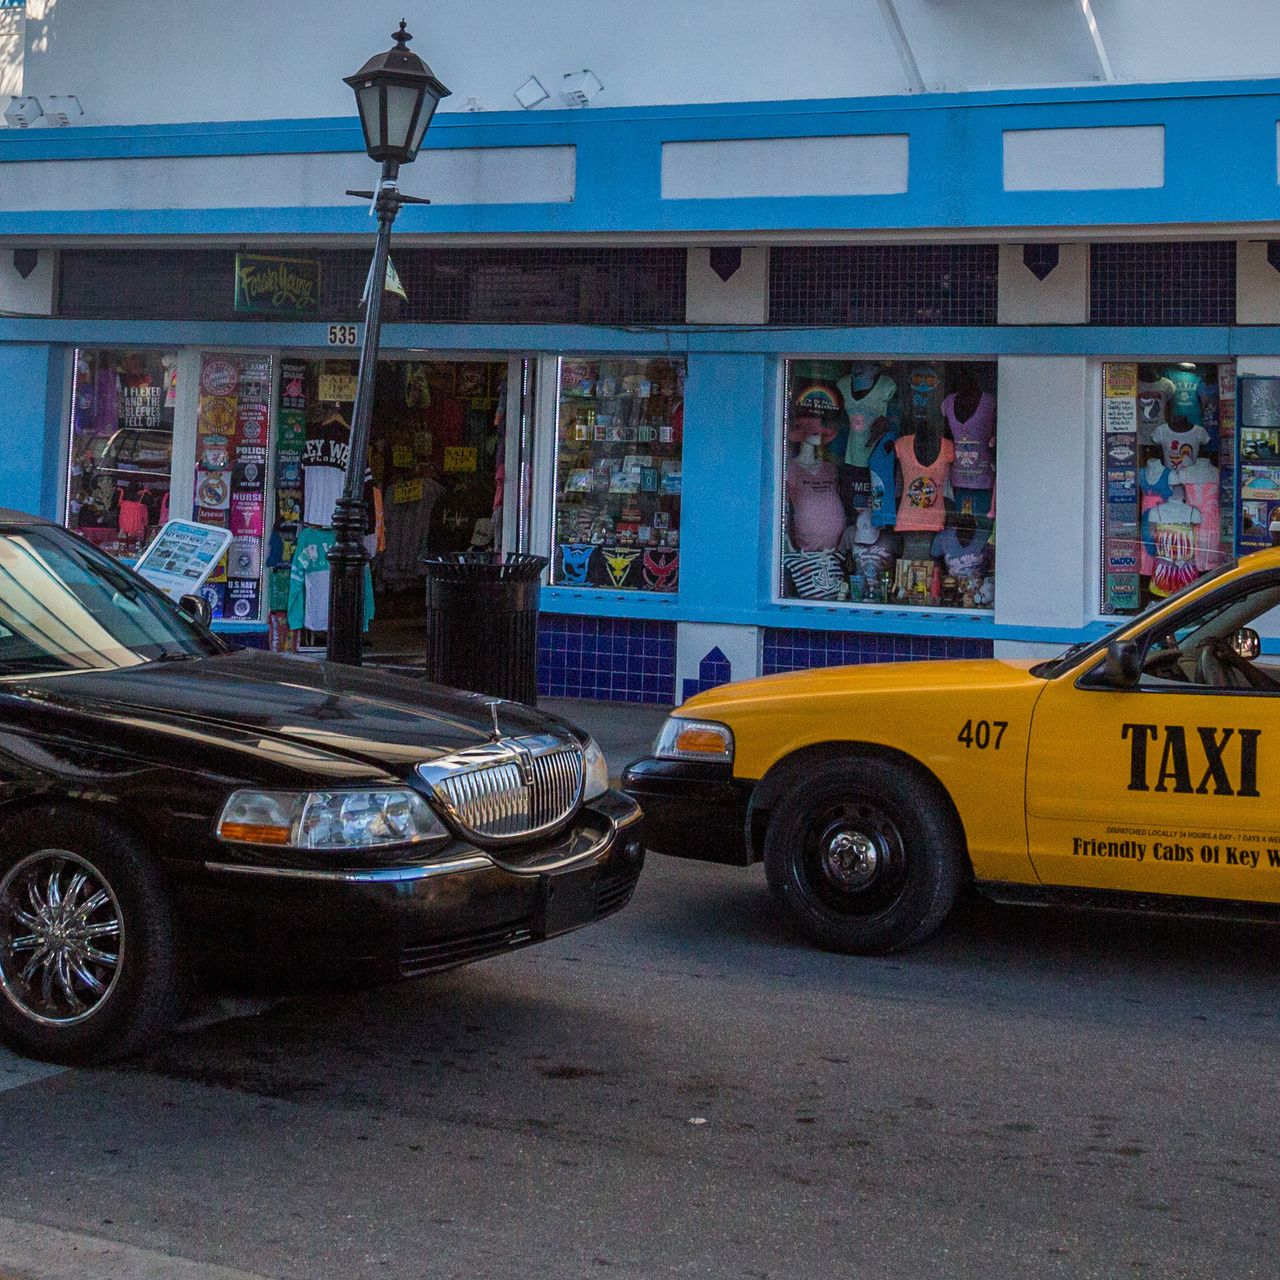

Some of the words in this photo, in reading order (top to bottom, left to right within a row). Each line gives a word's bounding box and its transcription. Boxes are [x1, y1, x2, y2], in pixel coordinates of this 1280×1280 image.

[329, 325, 356, 345] 535
[124, 386, 128, 397] I
[130, 386, 161, 397] FLEXED
[125, 397, 142, 407] AND
[146, 397, 161, 407] THE
[125, 406, 161, 417] SLEEVES
[125, 417, 143, 427] FELL
[146, 416, 161, 427] OFF
[236, 446, 266, 455] POLICE
[852, 482, 870, 492] 'ME
[233, 493, 263, 502] NURSE
[200, 510, 224, 518] Arsenal
[1110, 557, 1136, 566] DADDY
[957, 719, 1008, 750] 407
[1121, 723, 1262, 798] TAXI
[1106, 826, 1147, 836] DISPATCHED
[1148, 829, 1178, 837] LOCALLY
[1188, 831, 1212, 840] HOURS
[1219, 833, 1232, 841] DAY
[1243, 834, 1261, 842] DAYS
[1072, 838, 1146, 862] Friendly
[1153, 842, 1194, 862] Cabs
[1200, 845, 1220, 864] Of
[1225, 847, 1260, 868] Key
